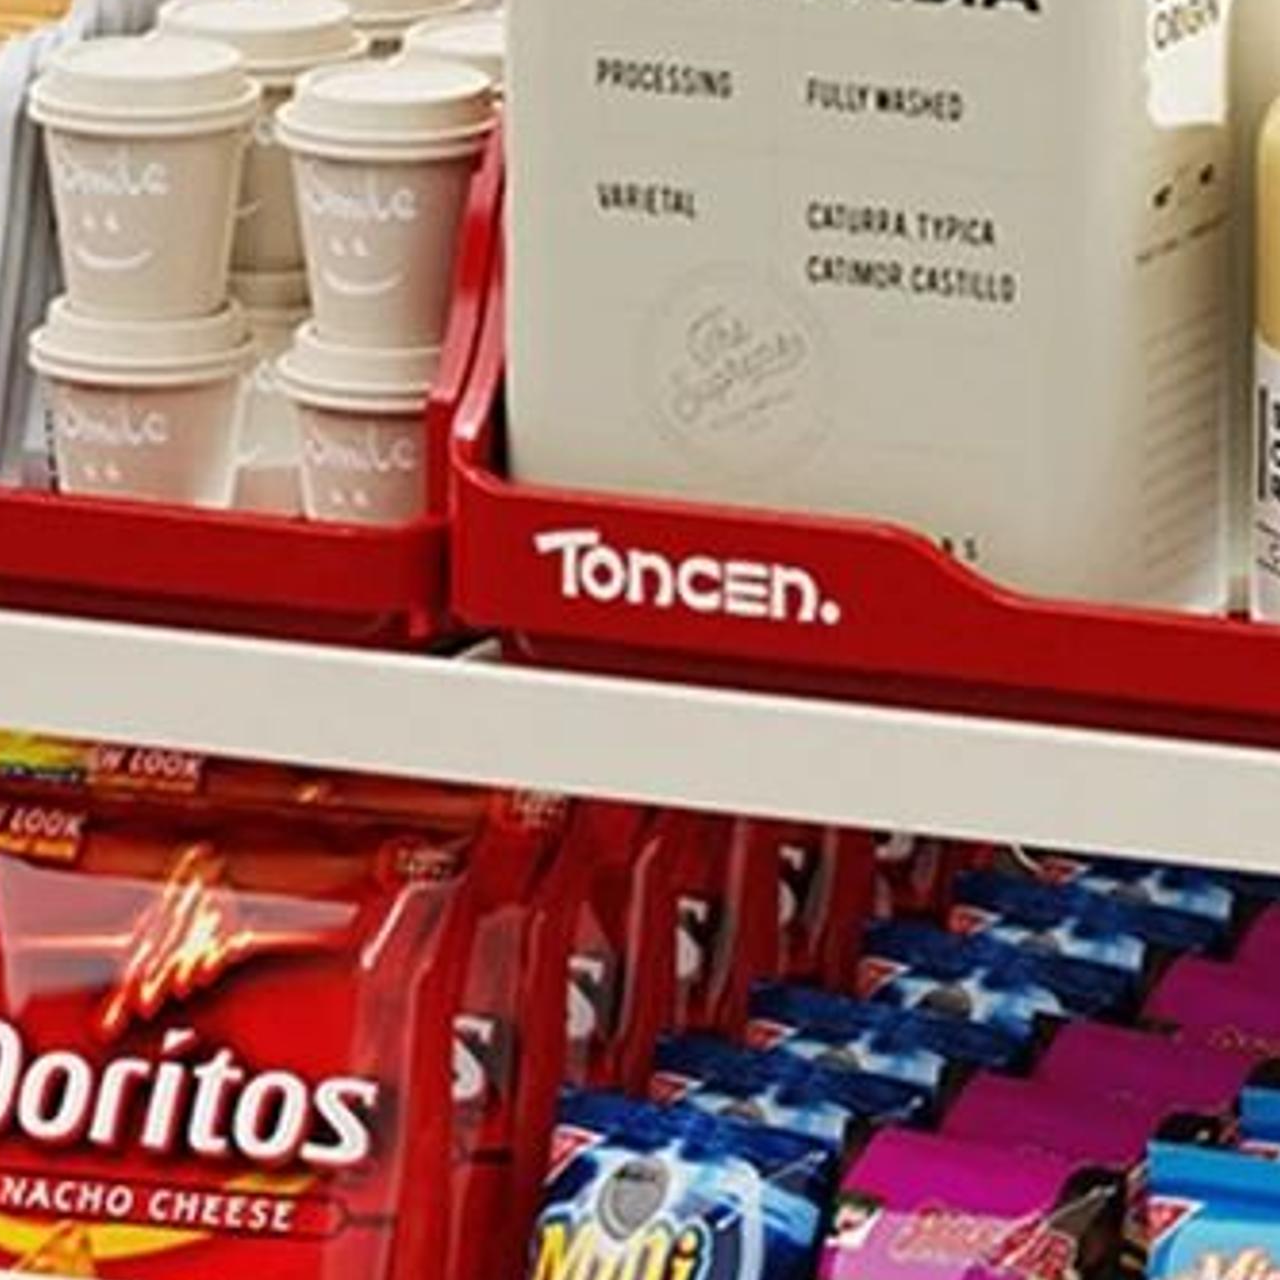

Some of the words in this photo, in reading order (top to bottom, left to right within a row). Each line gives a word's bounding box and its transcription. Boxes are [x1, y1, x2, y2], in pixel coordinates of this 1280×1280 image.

[596, 57, 733, 100] PROCESSING
[806, 78, 868, 112] FULLY
[874, 86, 964, 122] WASHED
[596, 182, 697, 219] VARIETAL
[916, 212, 996, 246] TYPICA
[912, 265, 1017, 304] CASTILLO
[147, 1187, 295, 1233] CHEESE
